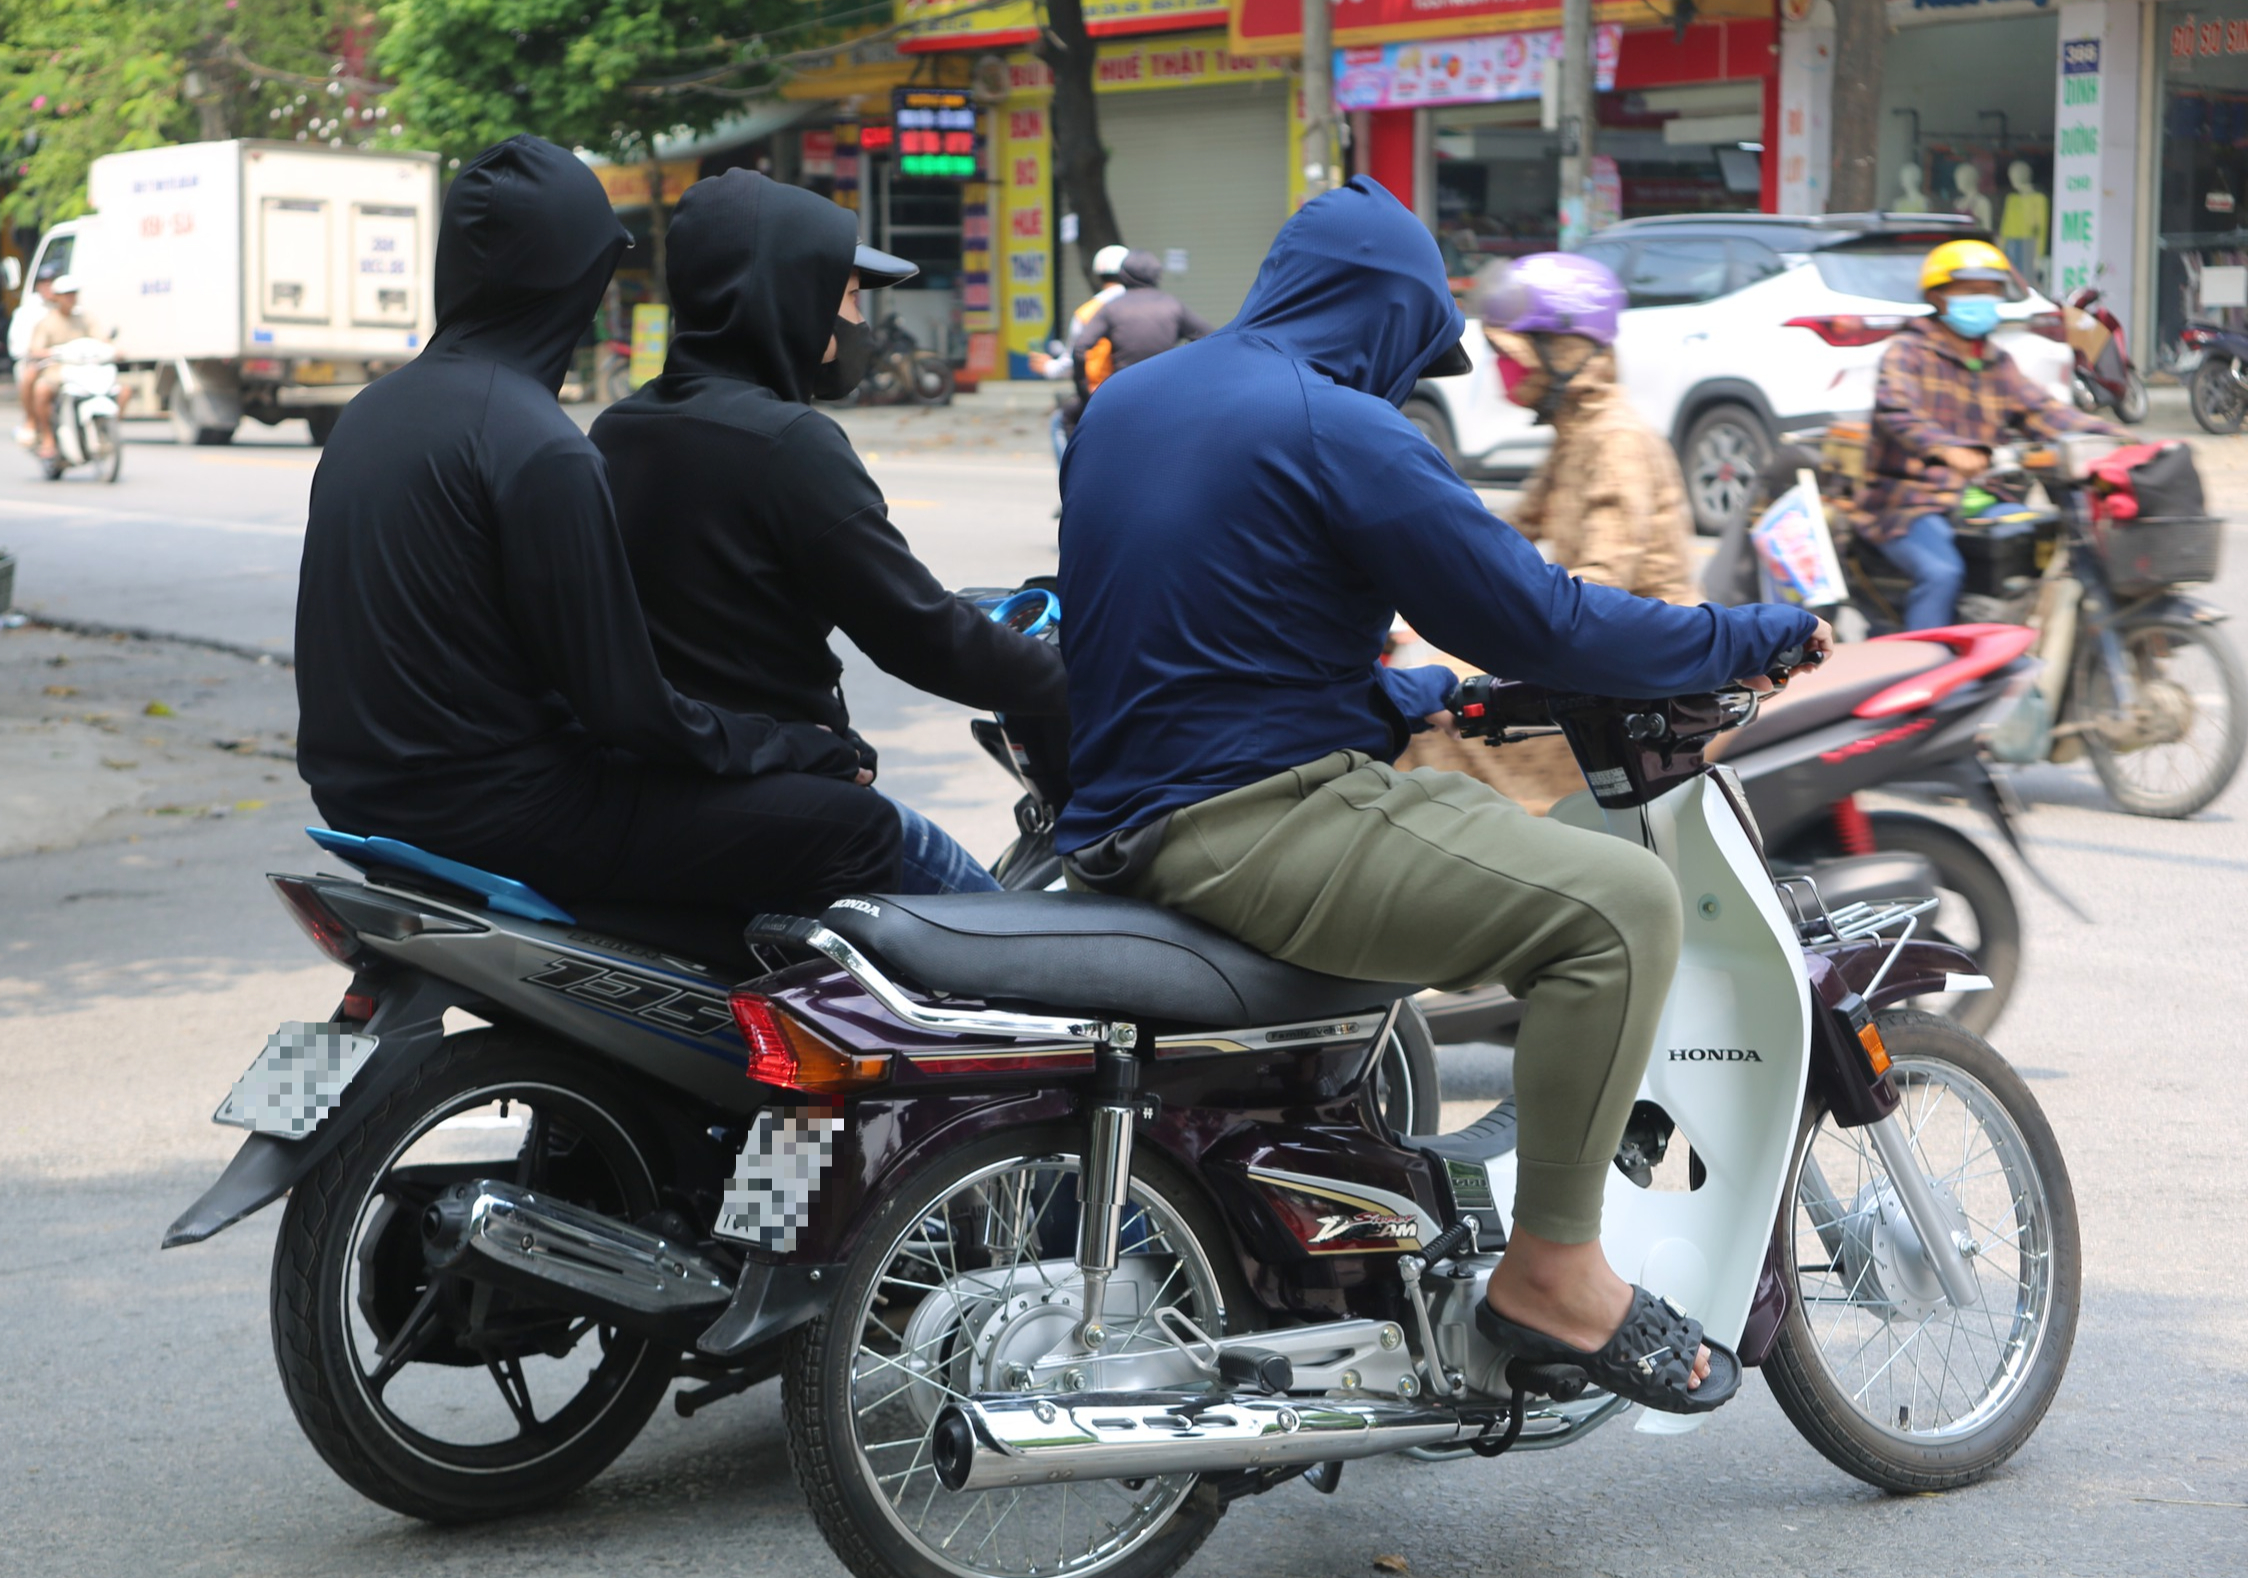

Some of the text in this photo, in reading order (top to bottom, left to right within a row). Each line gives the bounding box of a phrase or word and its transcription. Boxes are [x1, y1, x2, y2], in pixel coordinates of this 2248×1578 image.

[828, 898, 881, 918] HONDA
[520, 956, 736, 1037] 155
[1668, 1047, 1764, 1063] HONDA
